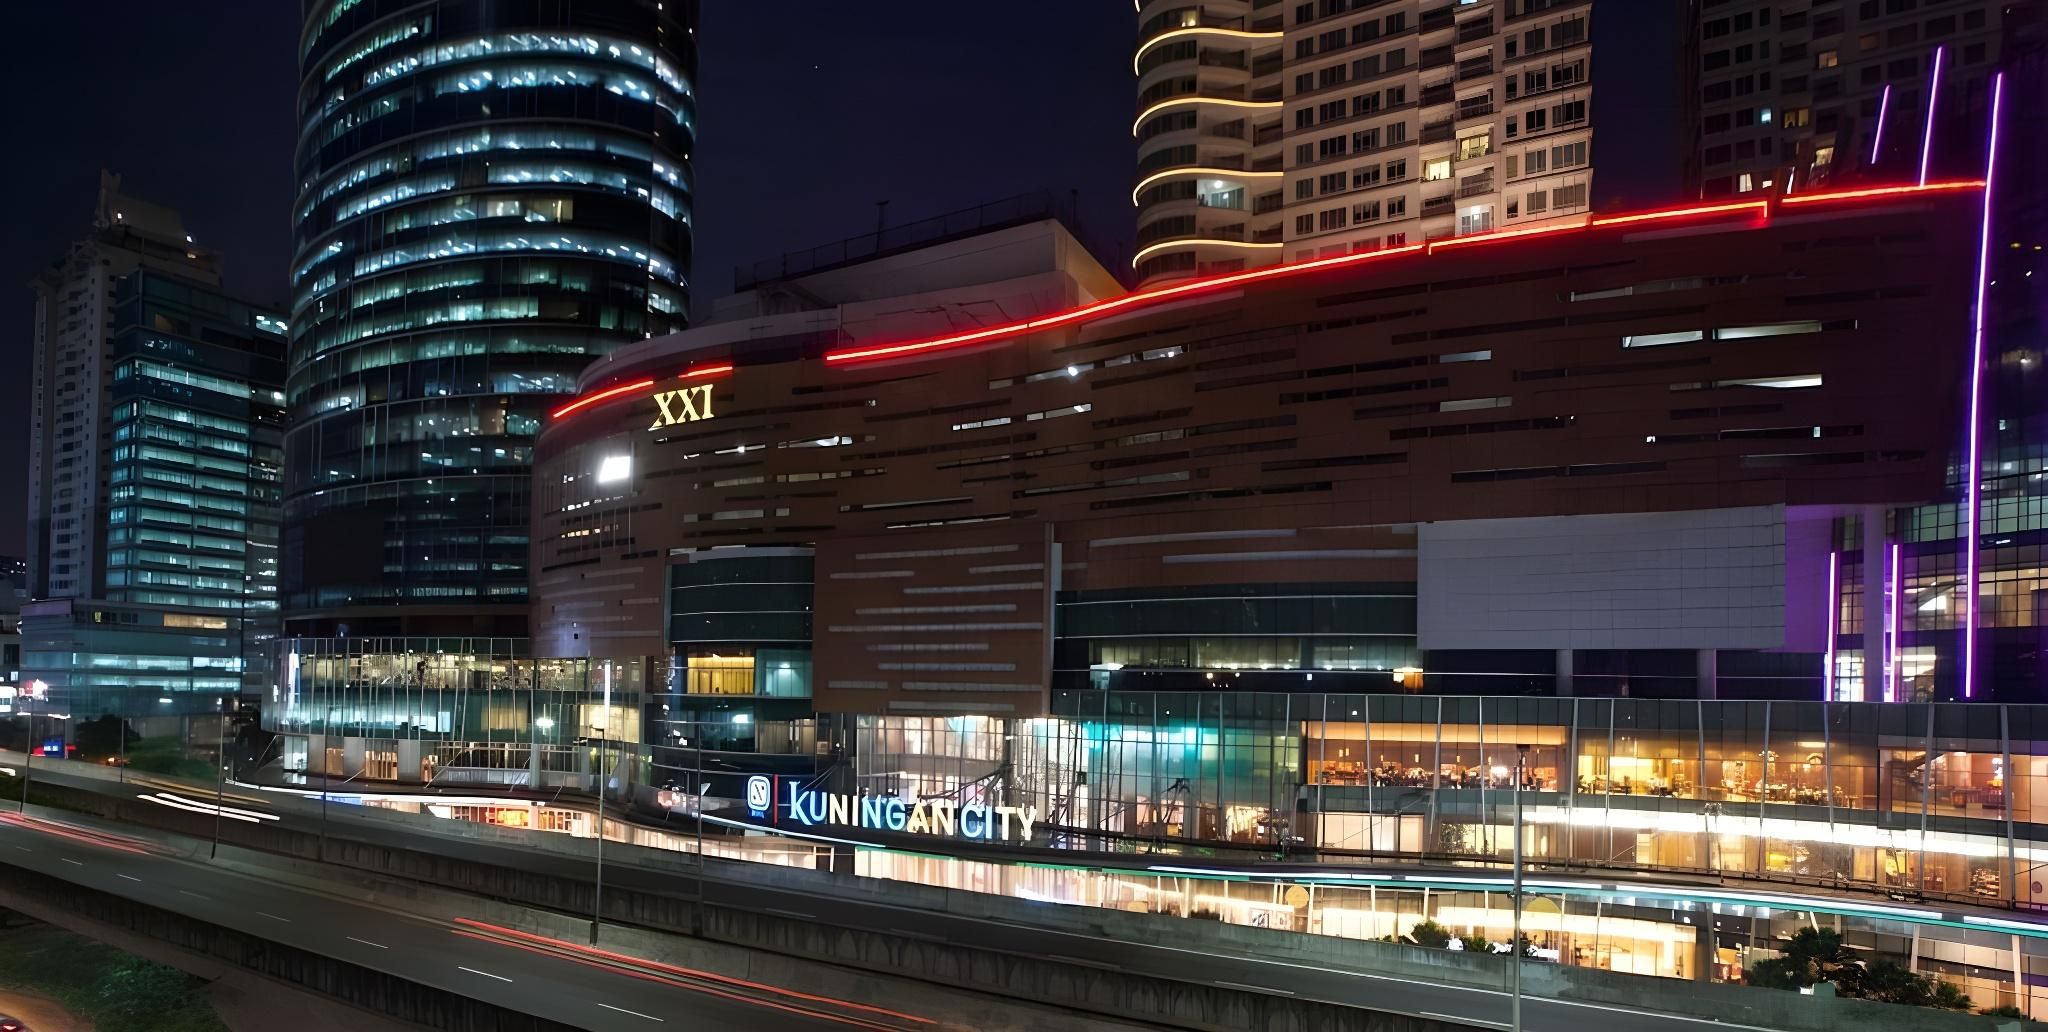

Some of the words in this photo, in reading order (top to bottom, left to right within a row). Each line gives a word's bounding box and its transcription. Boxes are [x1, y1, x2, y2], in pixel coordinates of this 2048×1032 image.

[648, 384, 714, 430] XXI
[789, 781, 954, 834] KUNINGAN
[961, 804, 1036, 841] CITY
